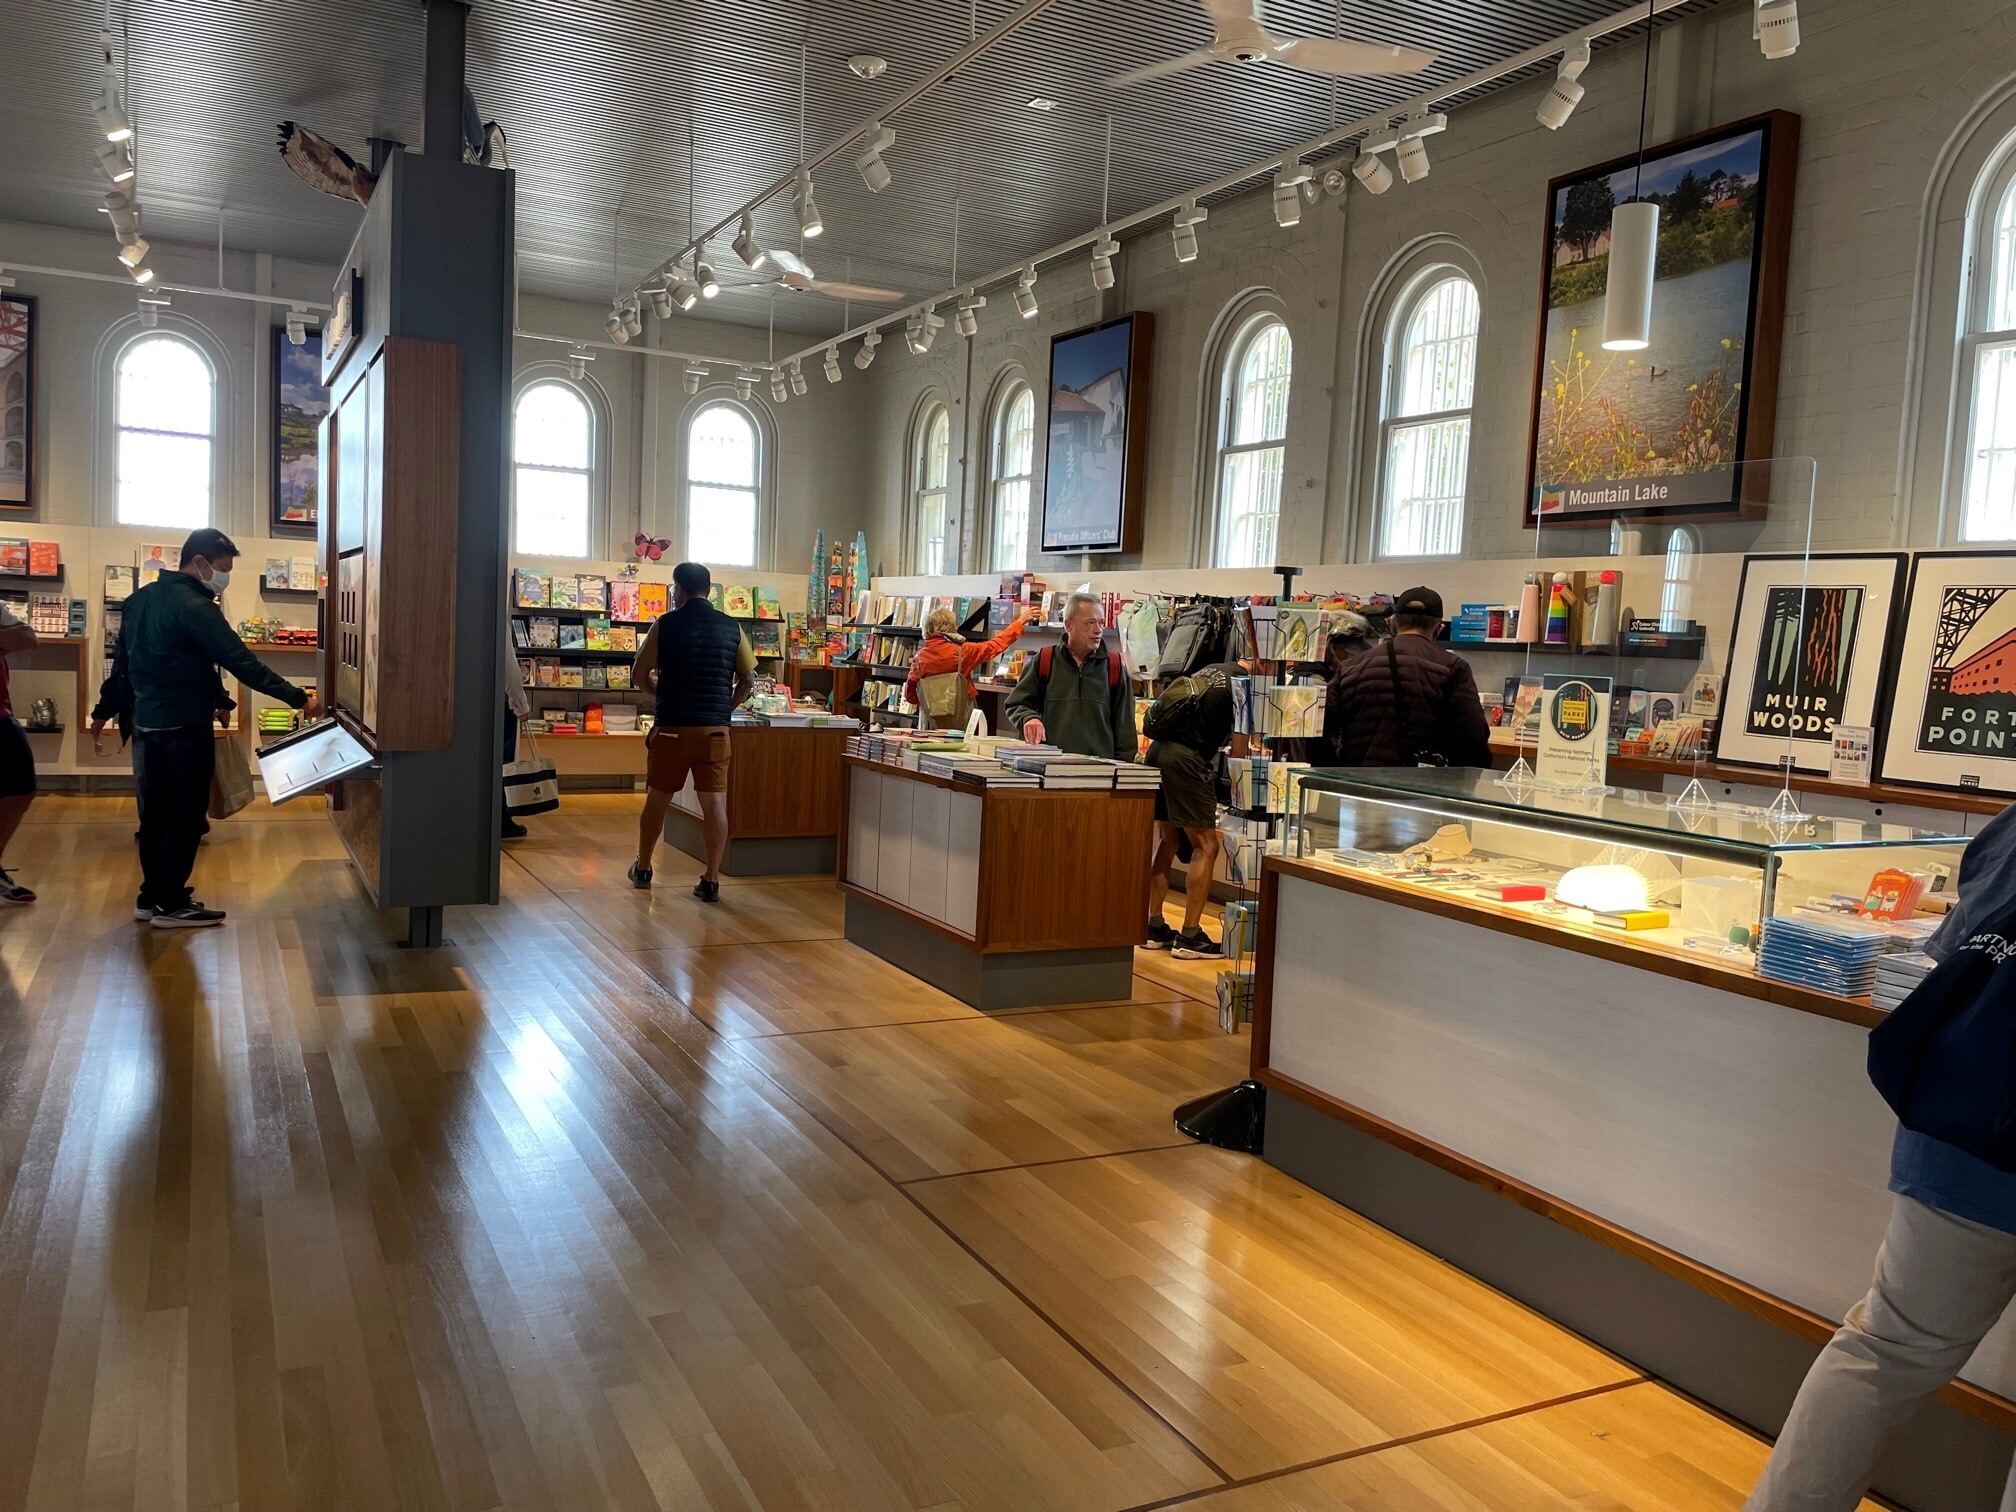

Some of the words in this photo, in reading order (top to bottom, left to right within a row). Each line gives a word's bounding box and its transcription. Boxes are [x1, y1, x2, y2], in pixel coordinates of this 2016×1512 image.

[1569, 485, 1630, 505] Mountain
[1634, 483, 1668, 501] Lake
[1765, 693, 1828, 712] MUIR
[1752, 711, 1836, 734] WOODS
[1941, 706, 2016, 726] FORT
